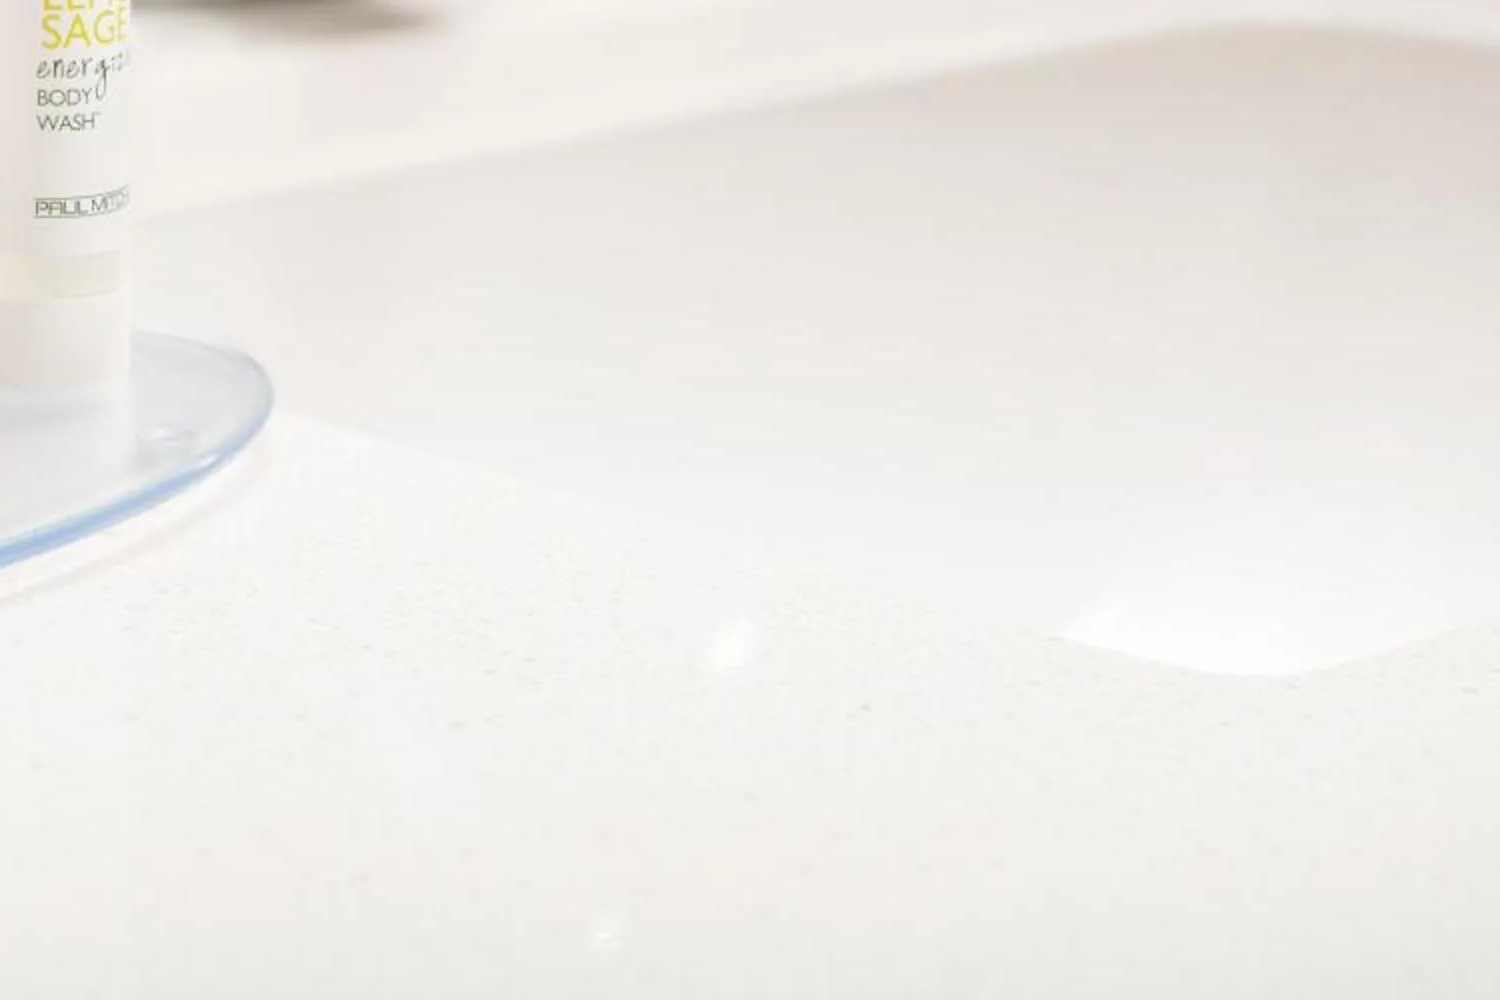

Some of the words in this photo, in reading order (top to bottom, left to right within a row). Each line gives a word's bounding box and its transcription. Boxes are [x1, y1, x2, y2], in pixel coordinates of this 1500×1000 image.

[41, 6, 128, 50] SAGE
[37, 87, 92, 107] BODY
[34, 200, 88, 215] PAUL
